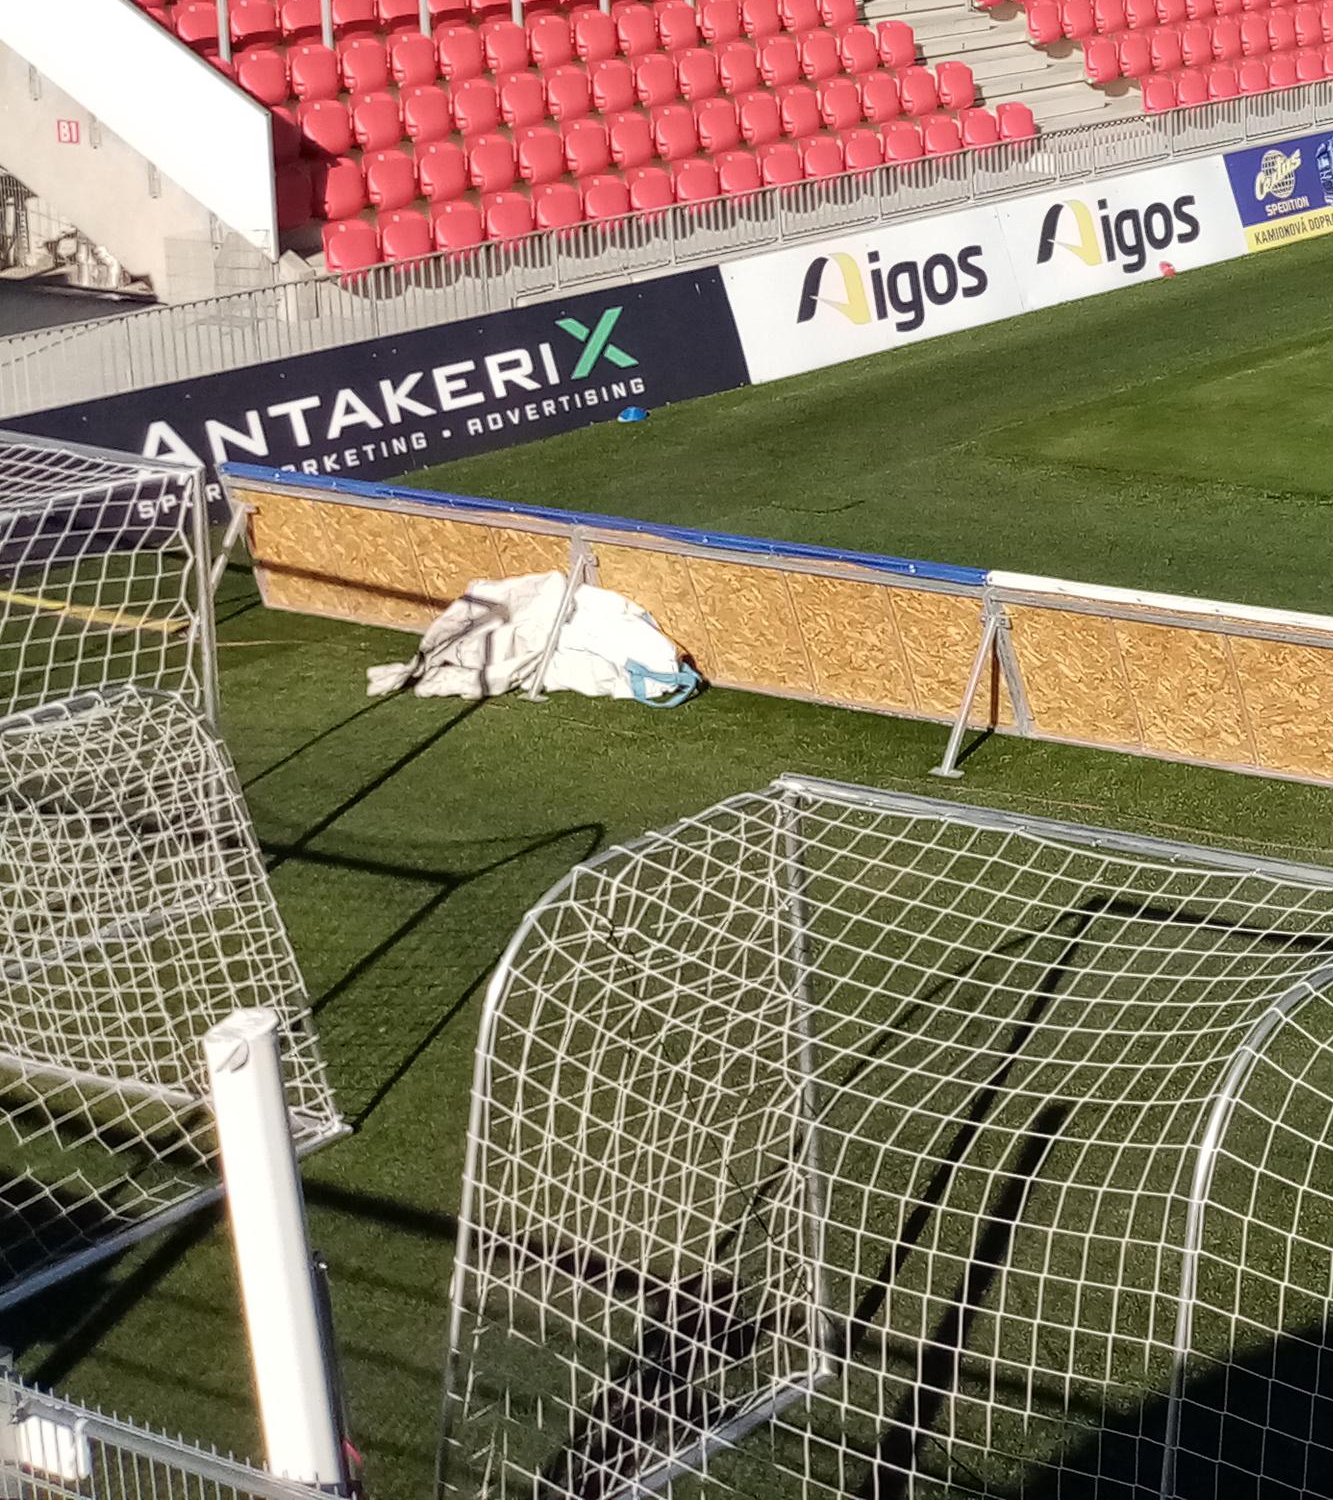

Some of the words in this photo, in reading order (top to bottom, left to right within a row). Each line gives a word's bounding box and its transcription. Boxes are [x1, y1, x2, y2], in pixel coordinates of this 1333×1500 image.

[60, 121, 77, 142] B1
[1265, 196, 1310, 217] SPEDITION
[1254, 216, 1307, 245] KAMIONOVÁ
[467, 376, 646, 436] ADVERTISING
